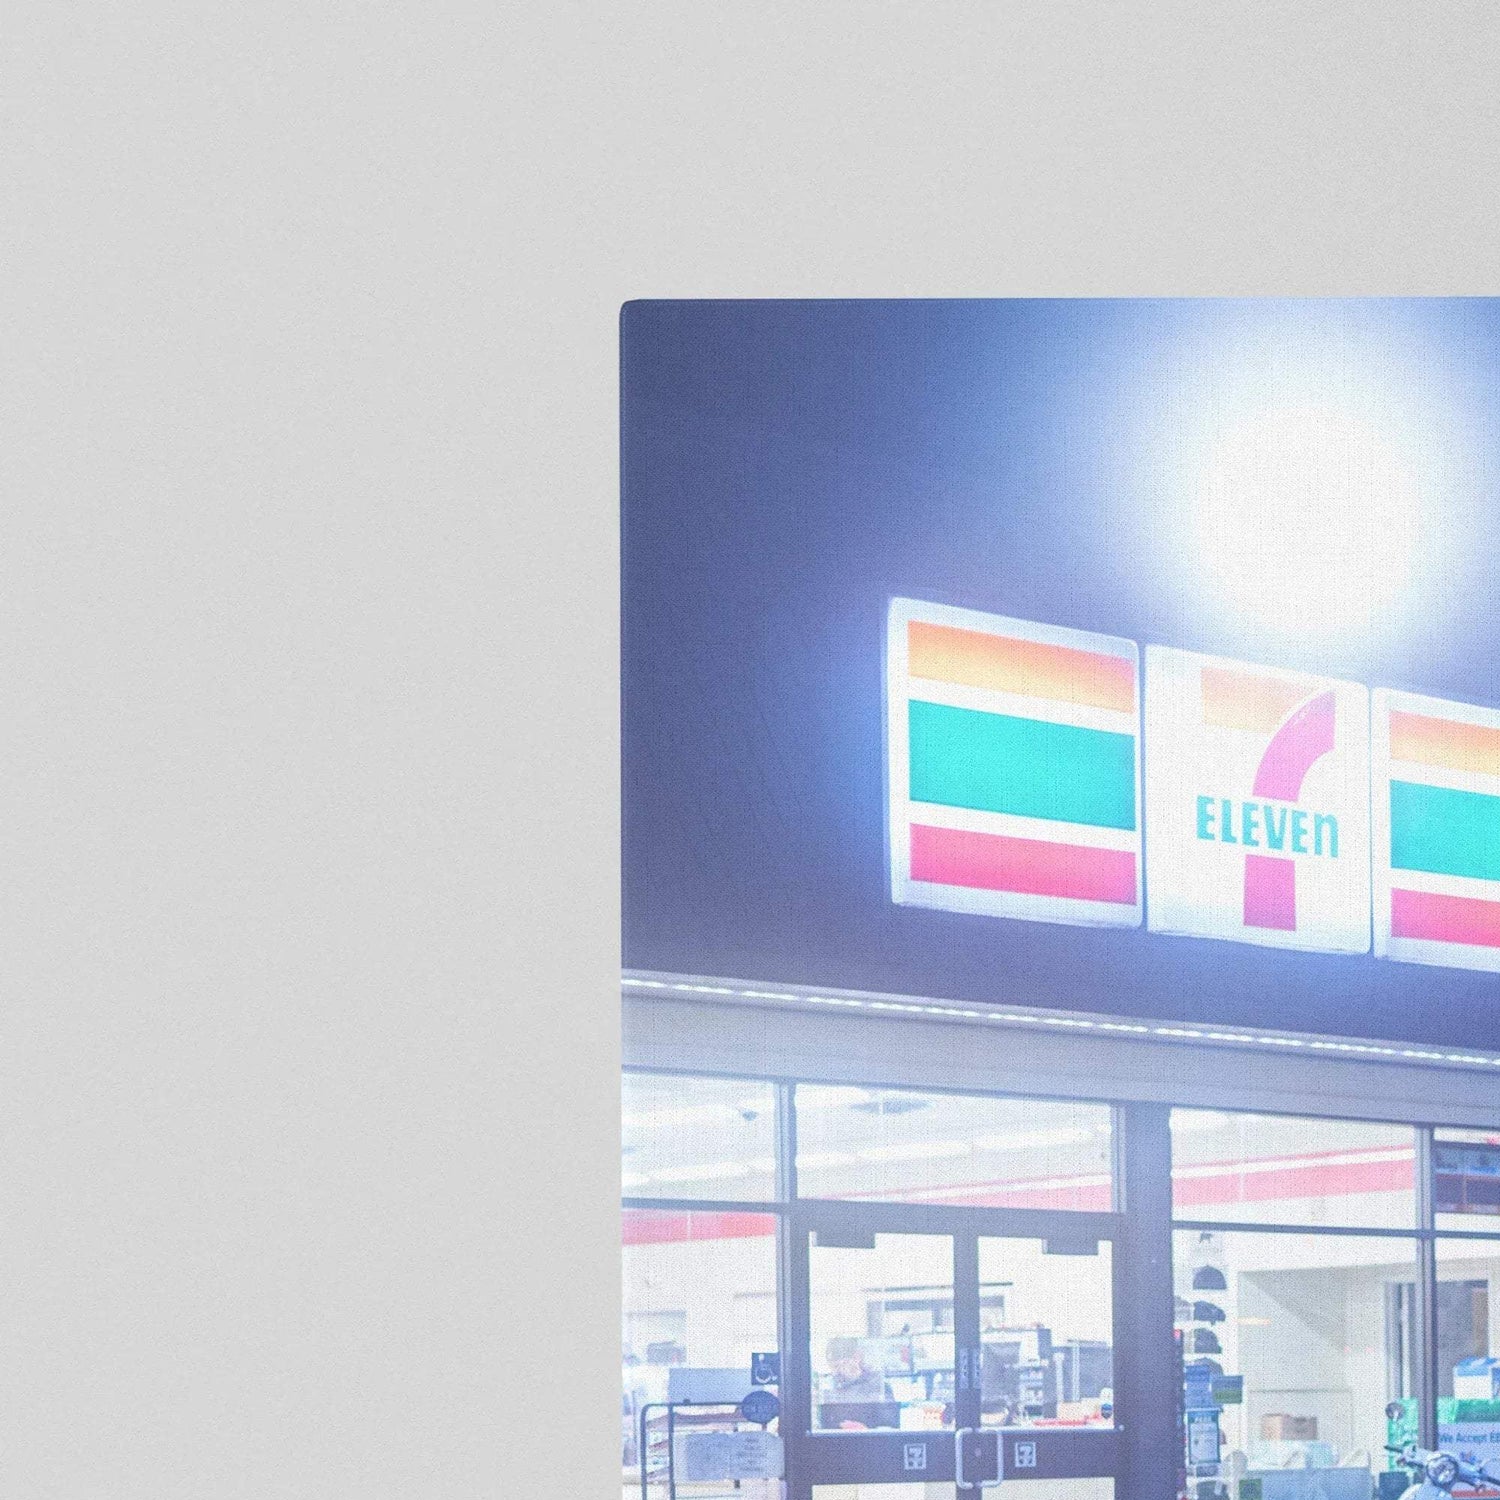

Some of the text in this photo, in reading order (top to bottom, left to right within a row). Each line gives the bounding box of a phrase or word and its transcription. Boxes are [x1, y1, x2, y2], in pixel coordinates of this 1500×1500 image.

[1200, 666, 1336, 931] 7
[1439, 1433, 1454, 1443] We
[1456, 1433, 1487, 1444] Accept
